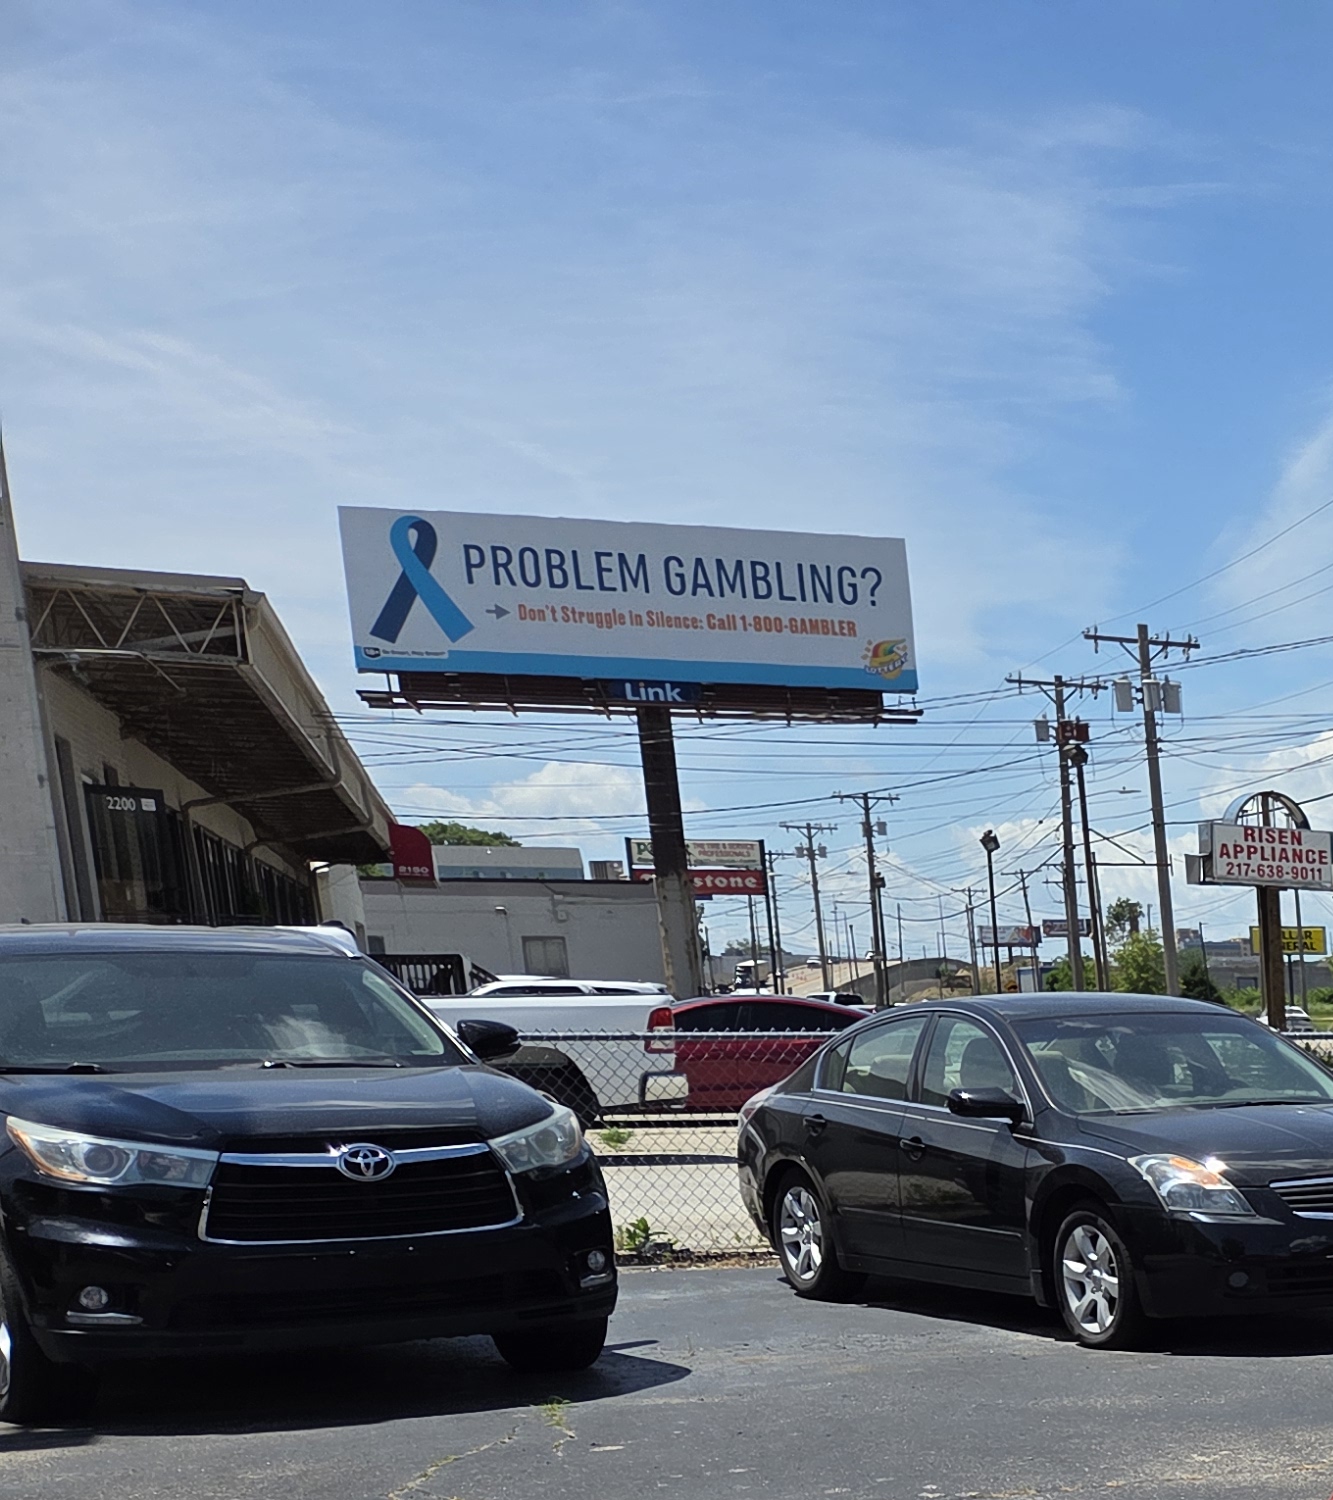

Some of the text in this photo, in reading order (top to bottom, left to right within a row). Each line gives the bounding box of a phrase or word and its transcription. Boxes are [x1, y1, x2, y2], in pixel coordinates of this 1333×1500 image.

[463, 543, 882, 607] PROBLEM GAMBLING?
[518, 603, 857, 637] Don't Struggle in Silence: Call 1-800-GAMBLER
[624, 682, 686, 702] Link
[106, 796, 136, 811] 2200
[1243, 827, 1303, 846] RISEN
[1219, 843, 1329, 866] APPLIANCE
[1225, 861, 1323, 882] 217-638-9011
